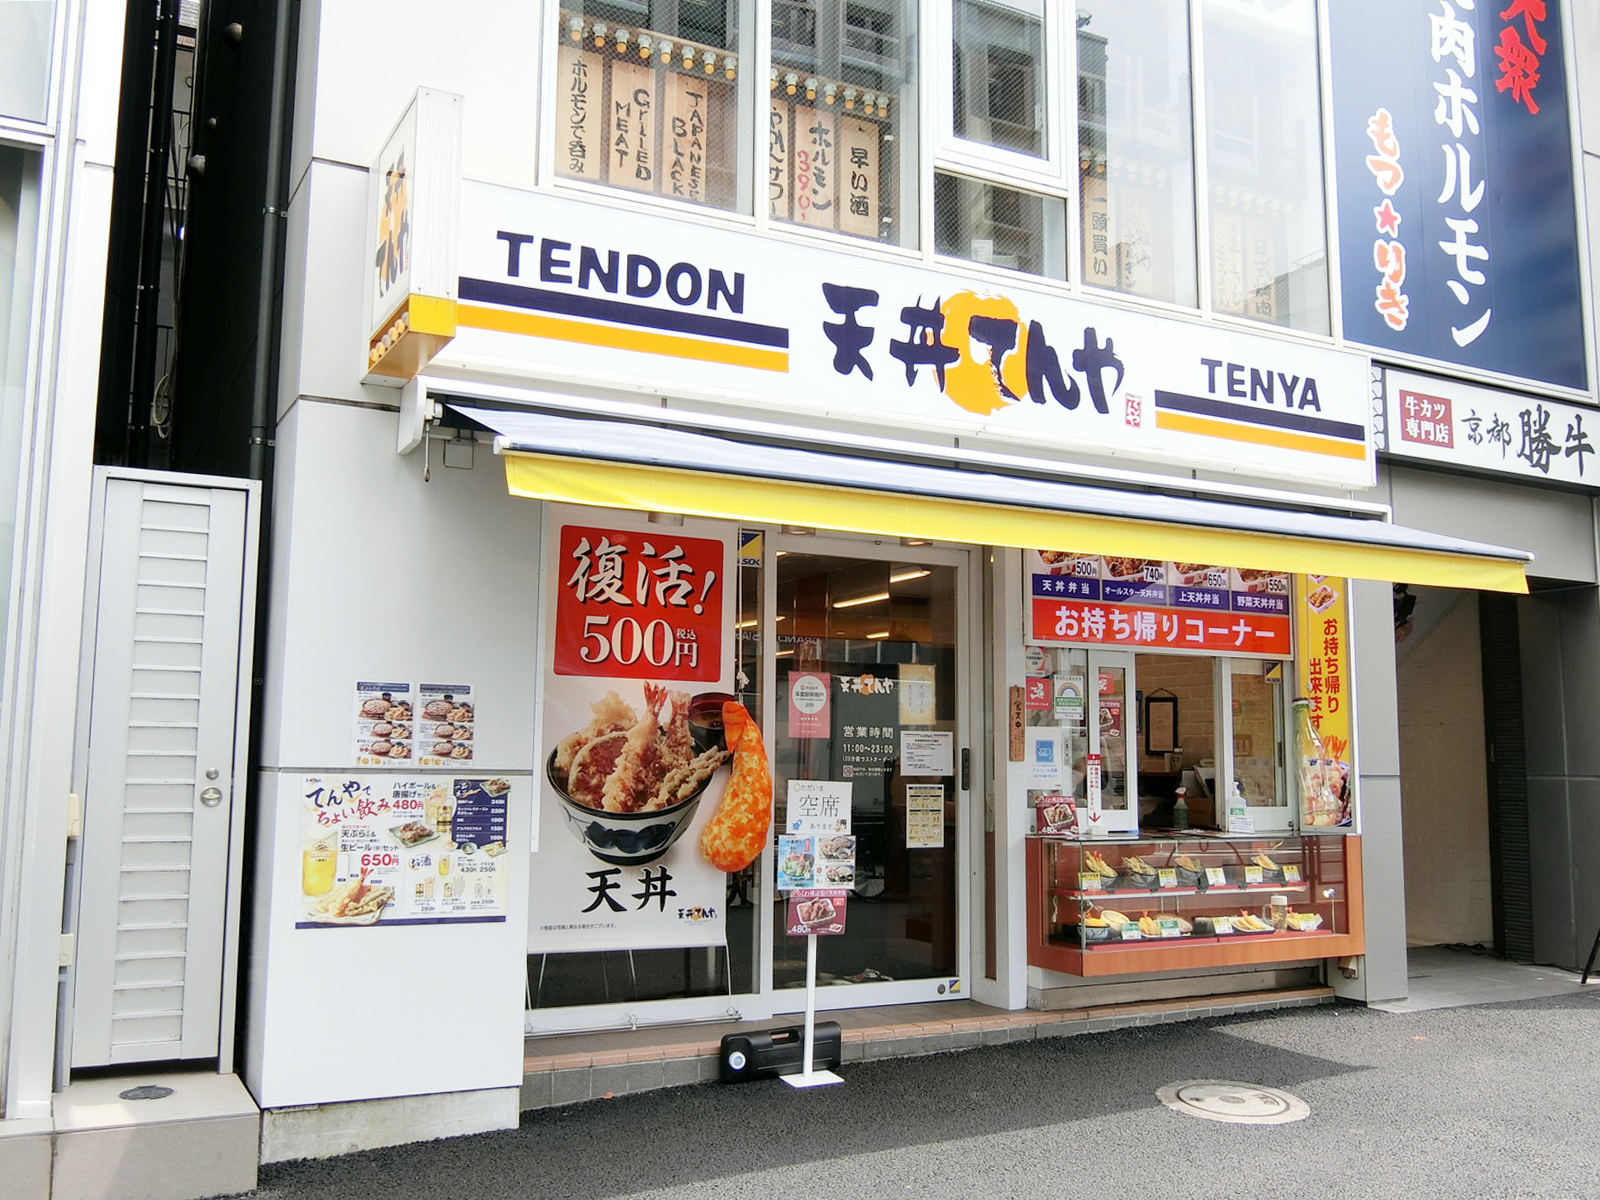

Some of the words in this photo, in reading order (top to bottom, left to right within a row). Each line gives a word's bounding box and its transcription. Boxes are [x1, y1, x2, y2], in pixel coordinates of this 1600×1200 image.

[615, 101, 631, 168] MEAT
[671, 117, 688, 196] BLACK
[809, 121, 832, 211] ホルモン
[850, 147, 869, 217] 早い酒
[1428, 0, 1492, 347] 肉ホルモン
[496, 230, 745, 315] TENDON
[1201, 357, 1322, 412] TENYA
[1405, 395, 1446, 420] 牛カツ
[1406, 417, 1450, 445] 専門店
[1461, 409, 1512, 460] 京都
[1042, 580, 1090, 595] 天丼弁当
[1104, 586, 1164, 599] オールスター天丼弁当
[1179, 591, 1220, 605] 上天丼弁当
[1236, 596, 1283, 610] 野菜天丼弁当
[1055, 605, 1275, 647] お持ち帰りコーナー
[1323, 618, 1341, 714] お持ち帰り
[1309, 657, 1323, 730] 出来ます
[842, 725, 895, 739] 営業時間
[305, 780, 372, 808] てんやで
[317, 798, 391, 826] ちょい飲み
[798, 794, 840, 818] 空席
[581, 865, 678, 913] 天丼
